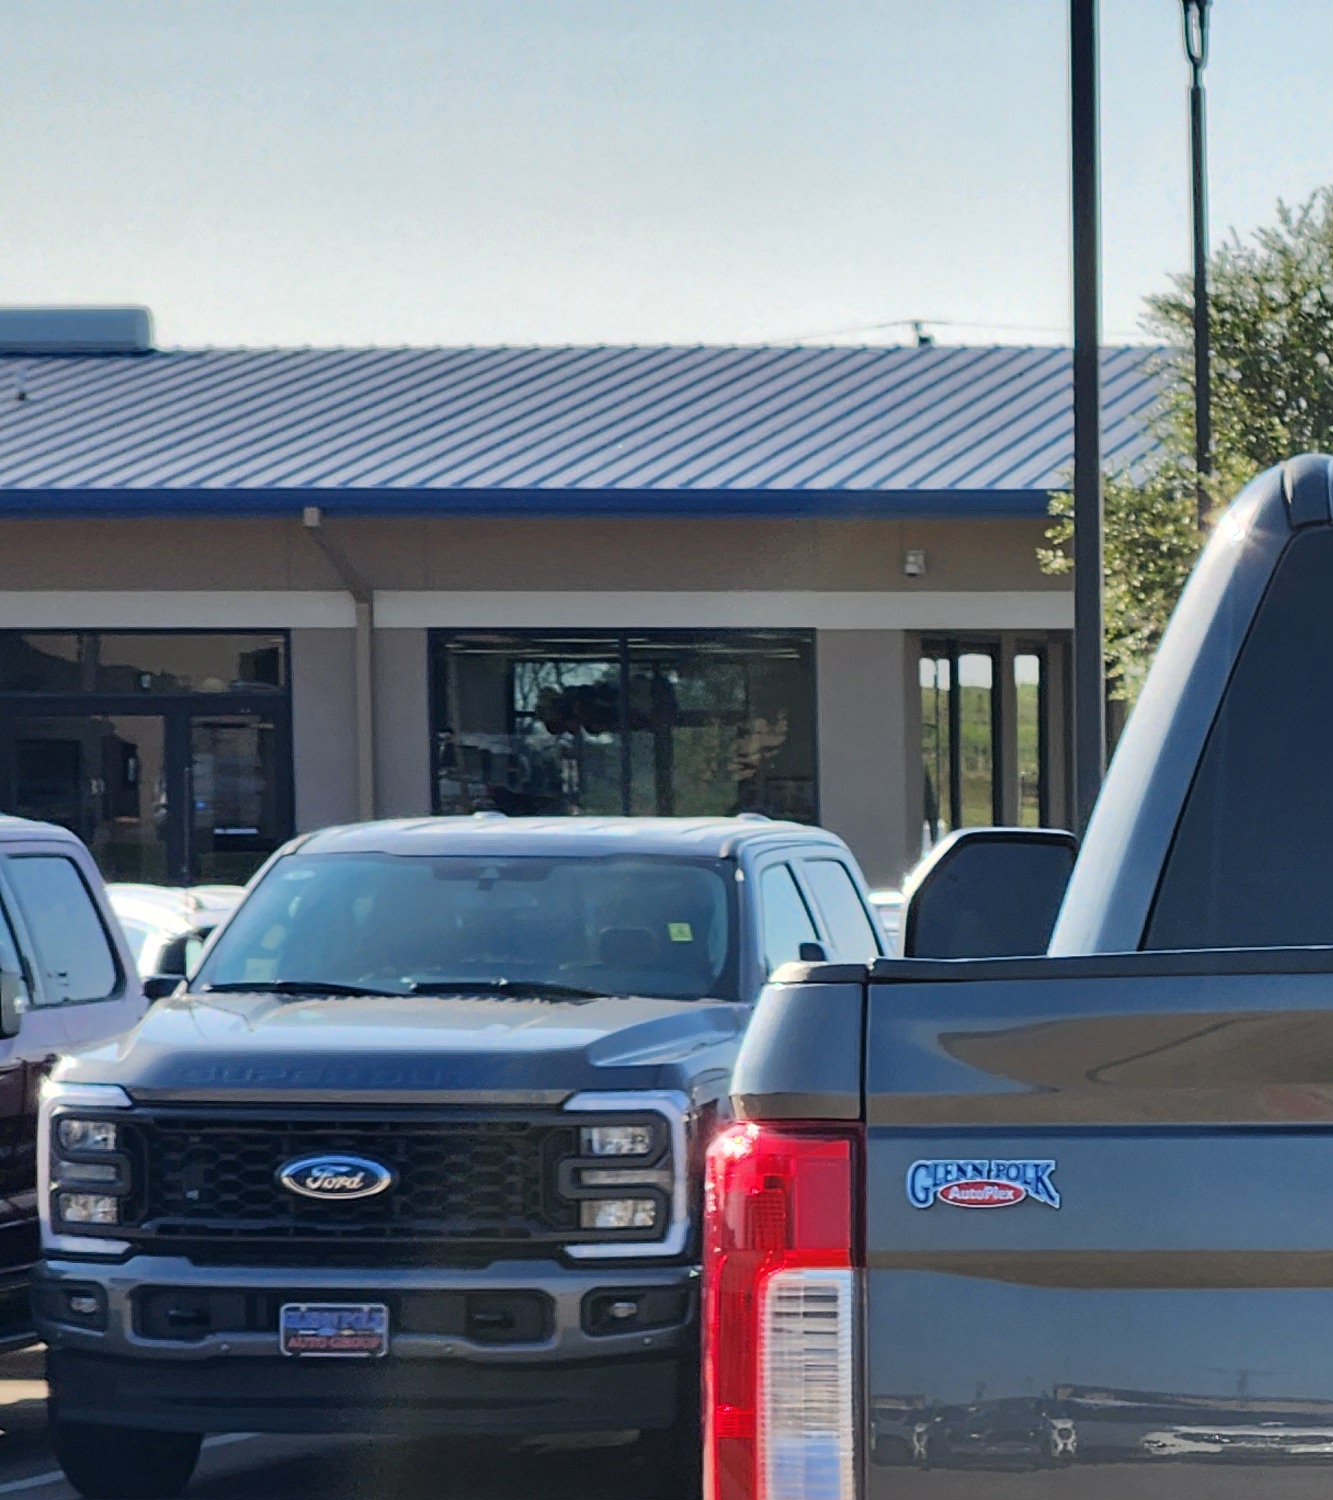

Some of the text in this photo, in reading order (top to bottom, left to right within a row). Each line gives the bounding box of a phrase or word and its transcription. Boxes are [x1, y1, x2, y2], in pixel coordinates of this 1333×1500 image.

[306, 1165, 365, 1190] Ford
[910, 1161, 1058, 1206] GLENN POLK
[947, 1185, 1015, 1200] AutoPlex
